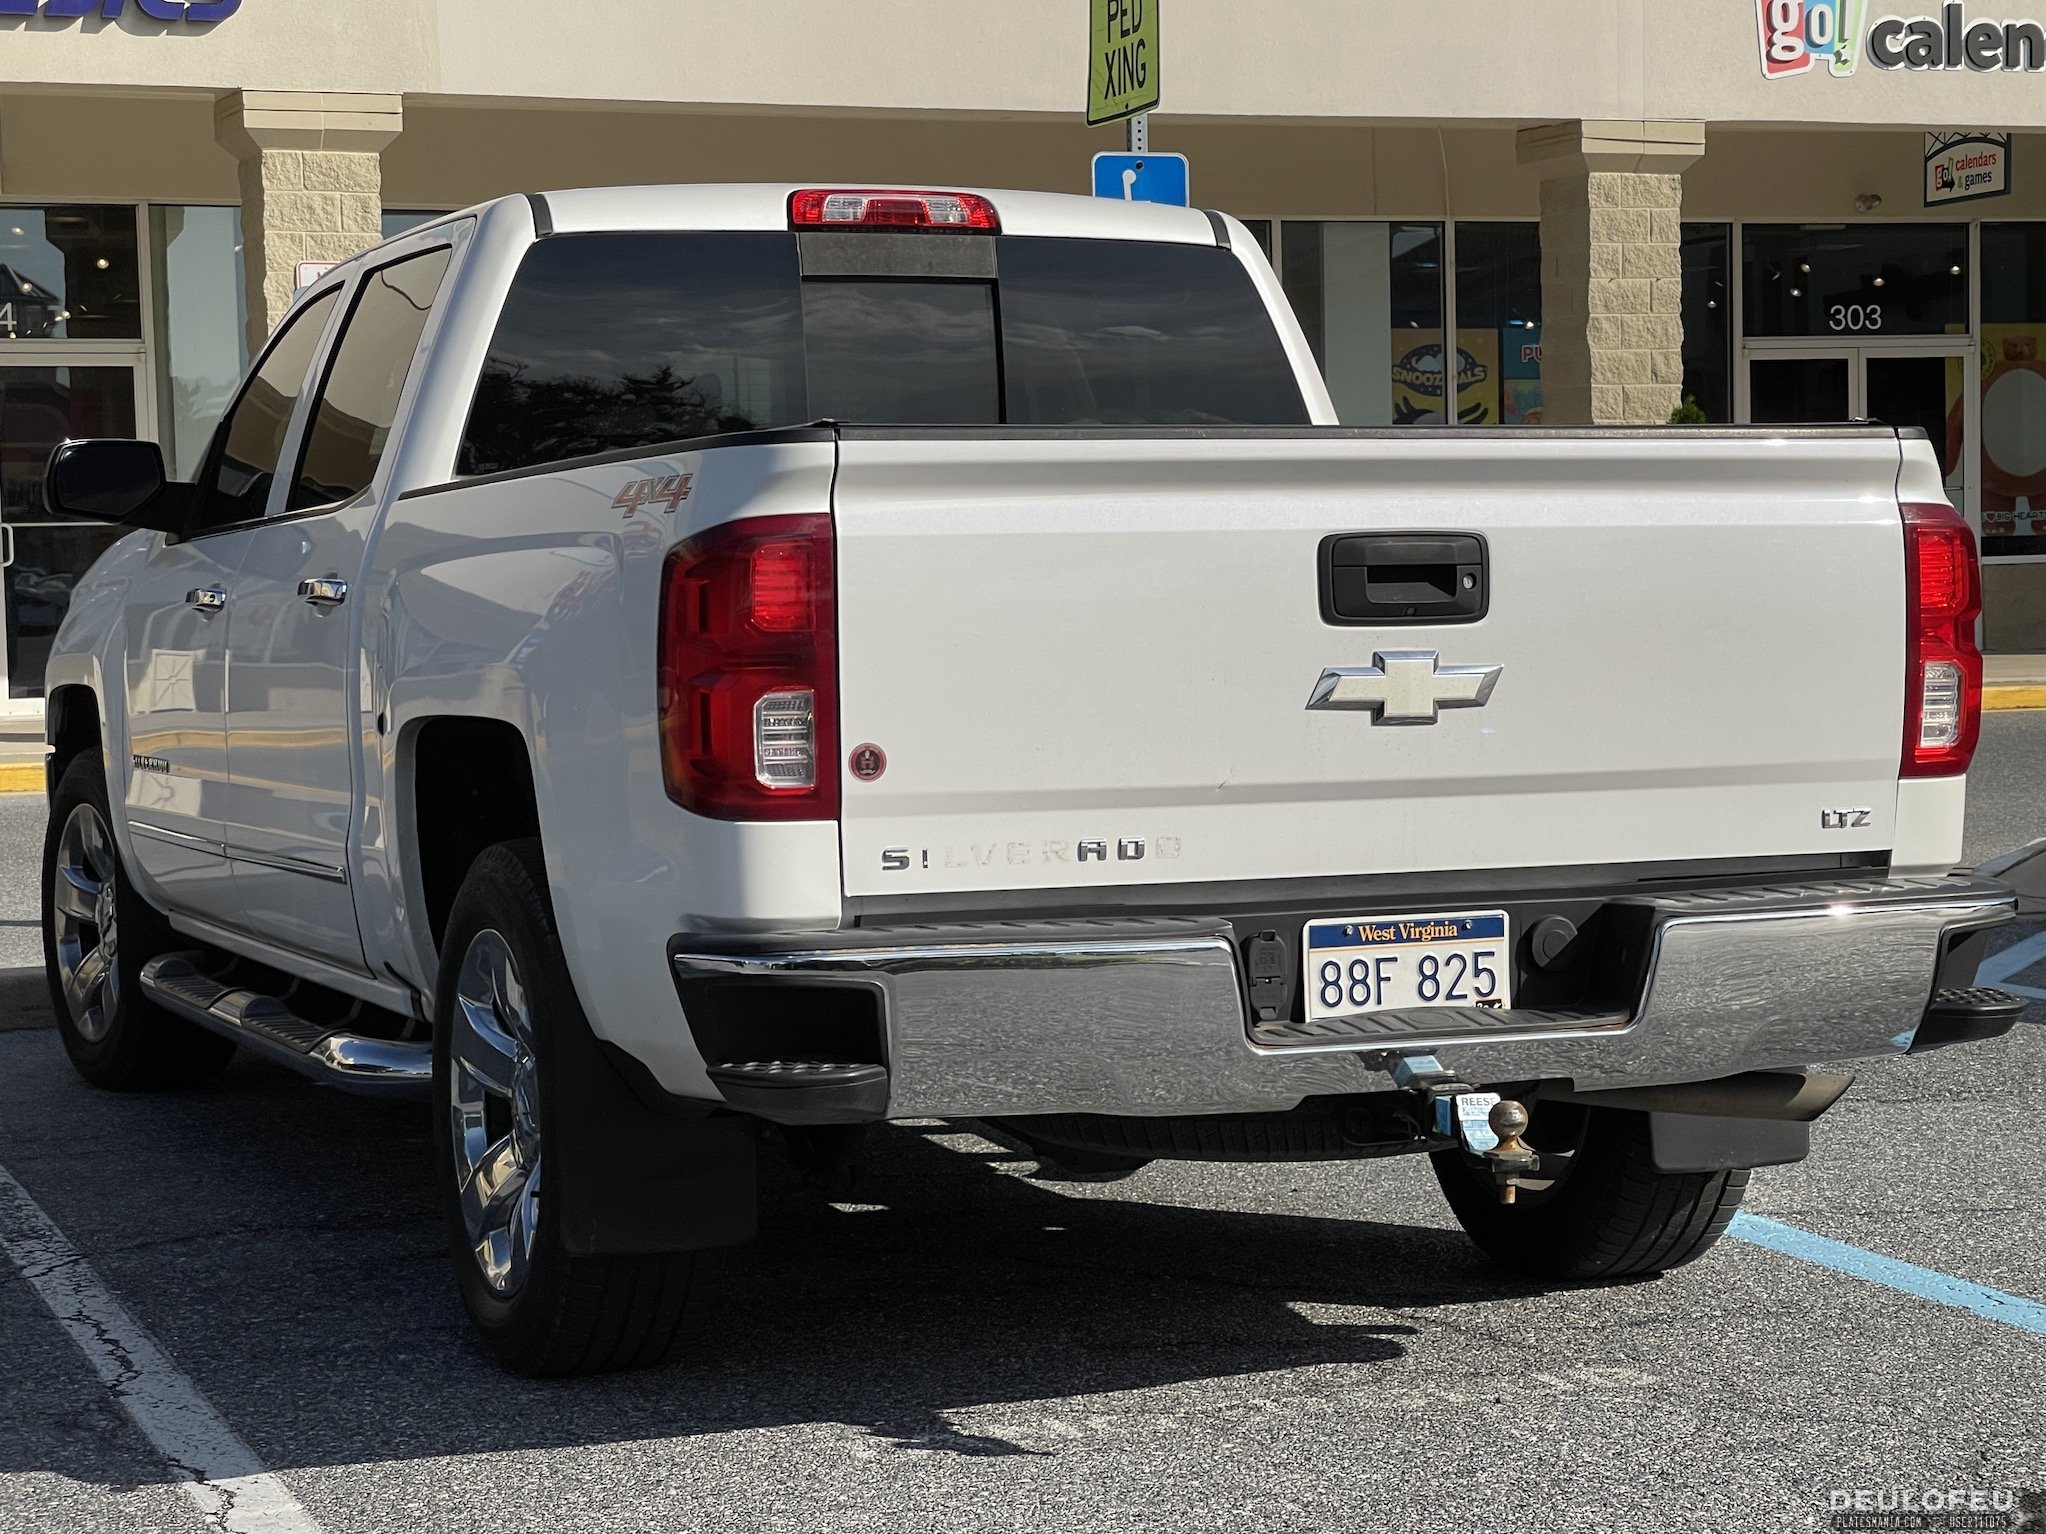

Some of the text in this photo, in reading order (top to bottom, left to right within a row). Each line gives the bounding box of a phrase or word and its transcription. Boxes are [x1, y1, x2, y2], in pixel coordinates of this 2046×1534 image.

[1108, 0, 1142, 43] PED
[1104, 38, 1146, 100] XING
[1956, 151, 1997, 171] calendars
[1965, 171, 1992, 190] games
[1829, 305, 1882, 330] 303
[1392, 366, 1487, 386] SNOOZALS
[1821, 808, 1871, 829] LTZ
[1358, 921, 1458, 942] West Virginia
[1320, 956, 1399, 1008] 88F
[1417, 951, 1497, 1002] 825
